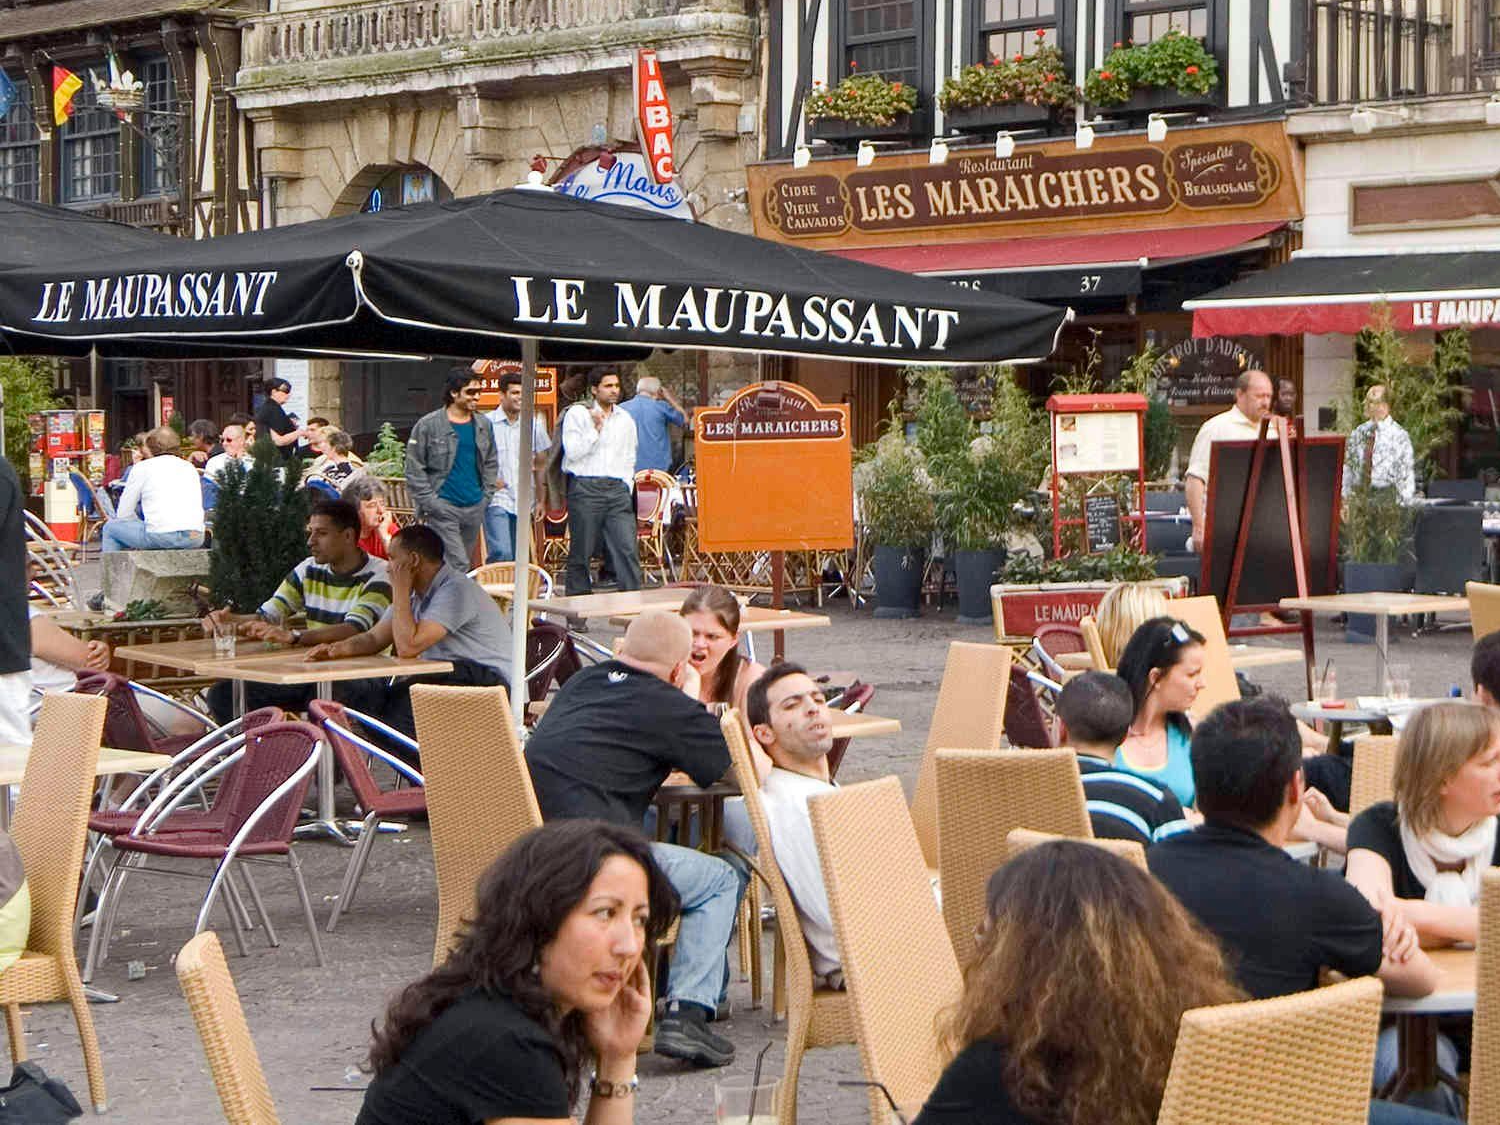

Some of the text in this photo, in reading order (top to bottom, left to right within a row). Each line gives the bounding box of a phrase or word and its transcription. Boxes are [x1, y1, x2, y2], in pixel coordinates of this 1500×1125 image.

[642, 54, 673, 179] TABAC
[960, 155, 1033, 174] Restaurant
[781, 183, 817, 198] CIDRE
[856, 163, 1161, 222] LES MARAICHERS
[1183, 181, 1256, 196] BEAUJOLAIS
[784, 202, 820, 216] VIEUX
[786, 215, 846, 230] CALVADOS
[1080, 276, 1101, 293] 37
[32, 271, 278, 322] LE MAUPASSANT
[510, 276, 960, 351] LE MAUPASSANT
[1413, 301, 1433, 325] LE
[705, 419, 839, 436] LES MARAICHERS
[1034, 604, 1100, 622] LE MAUPA
